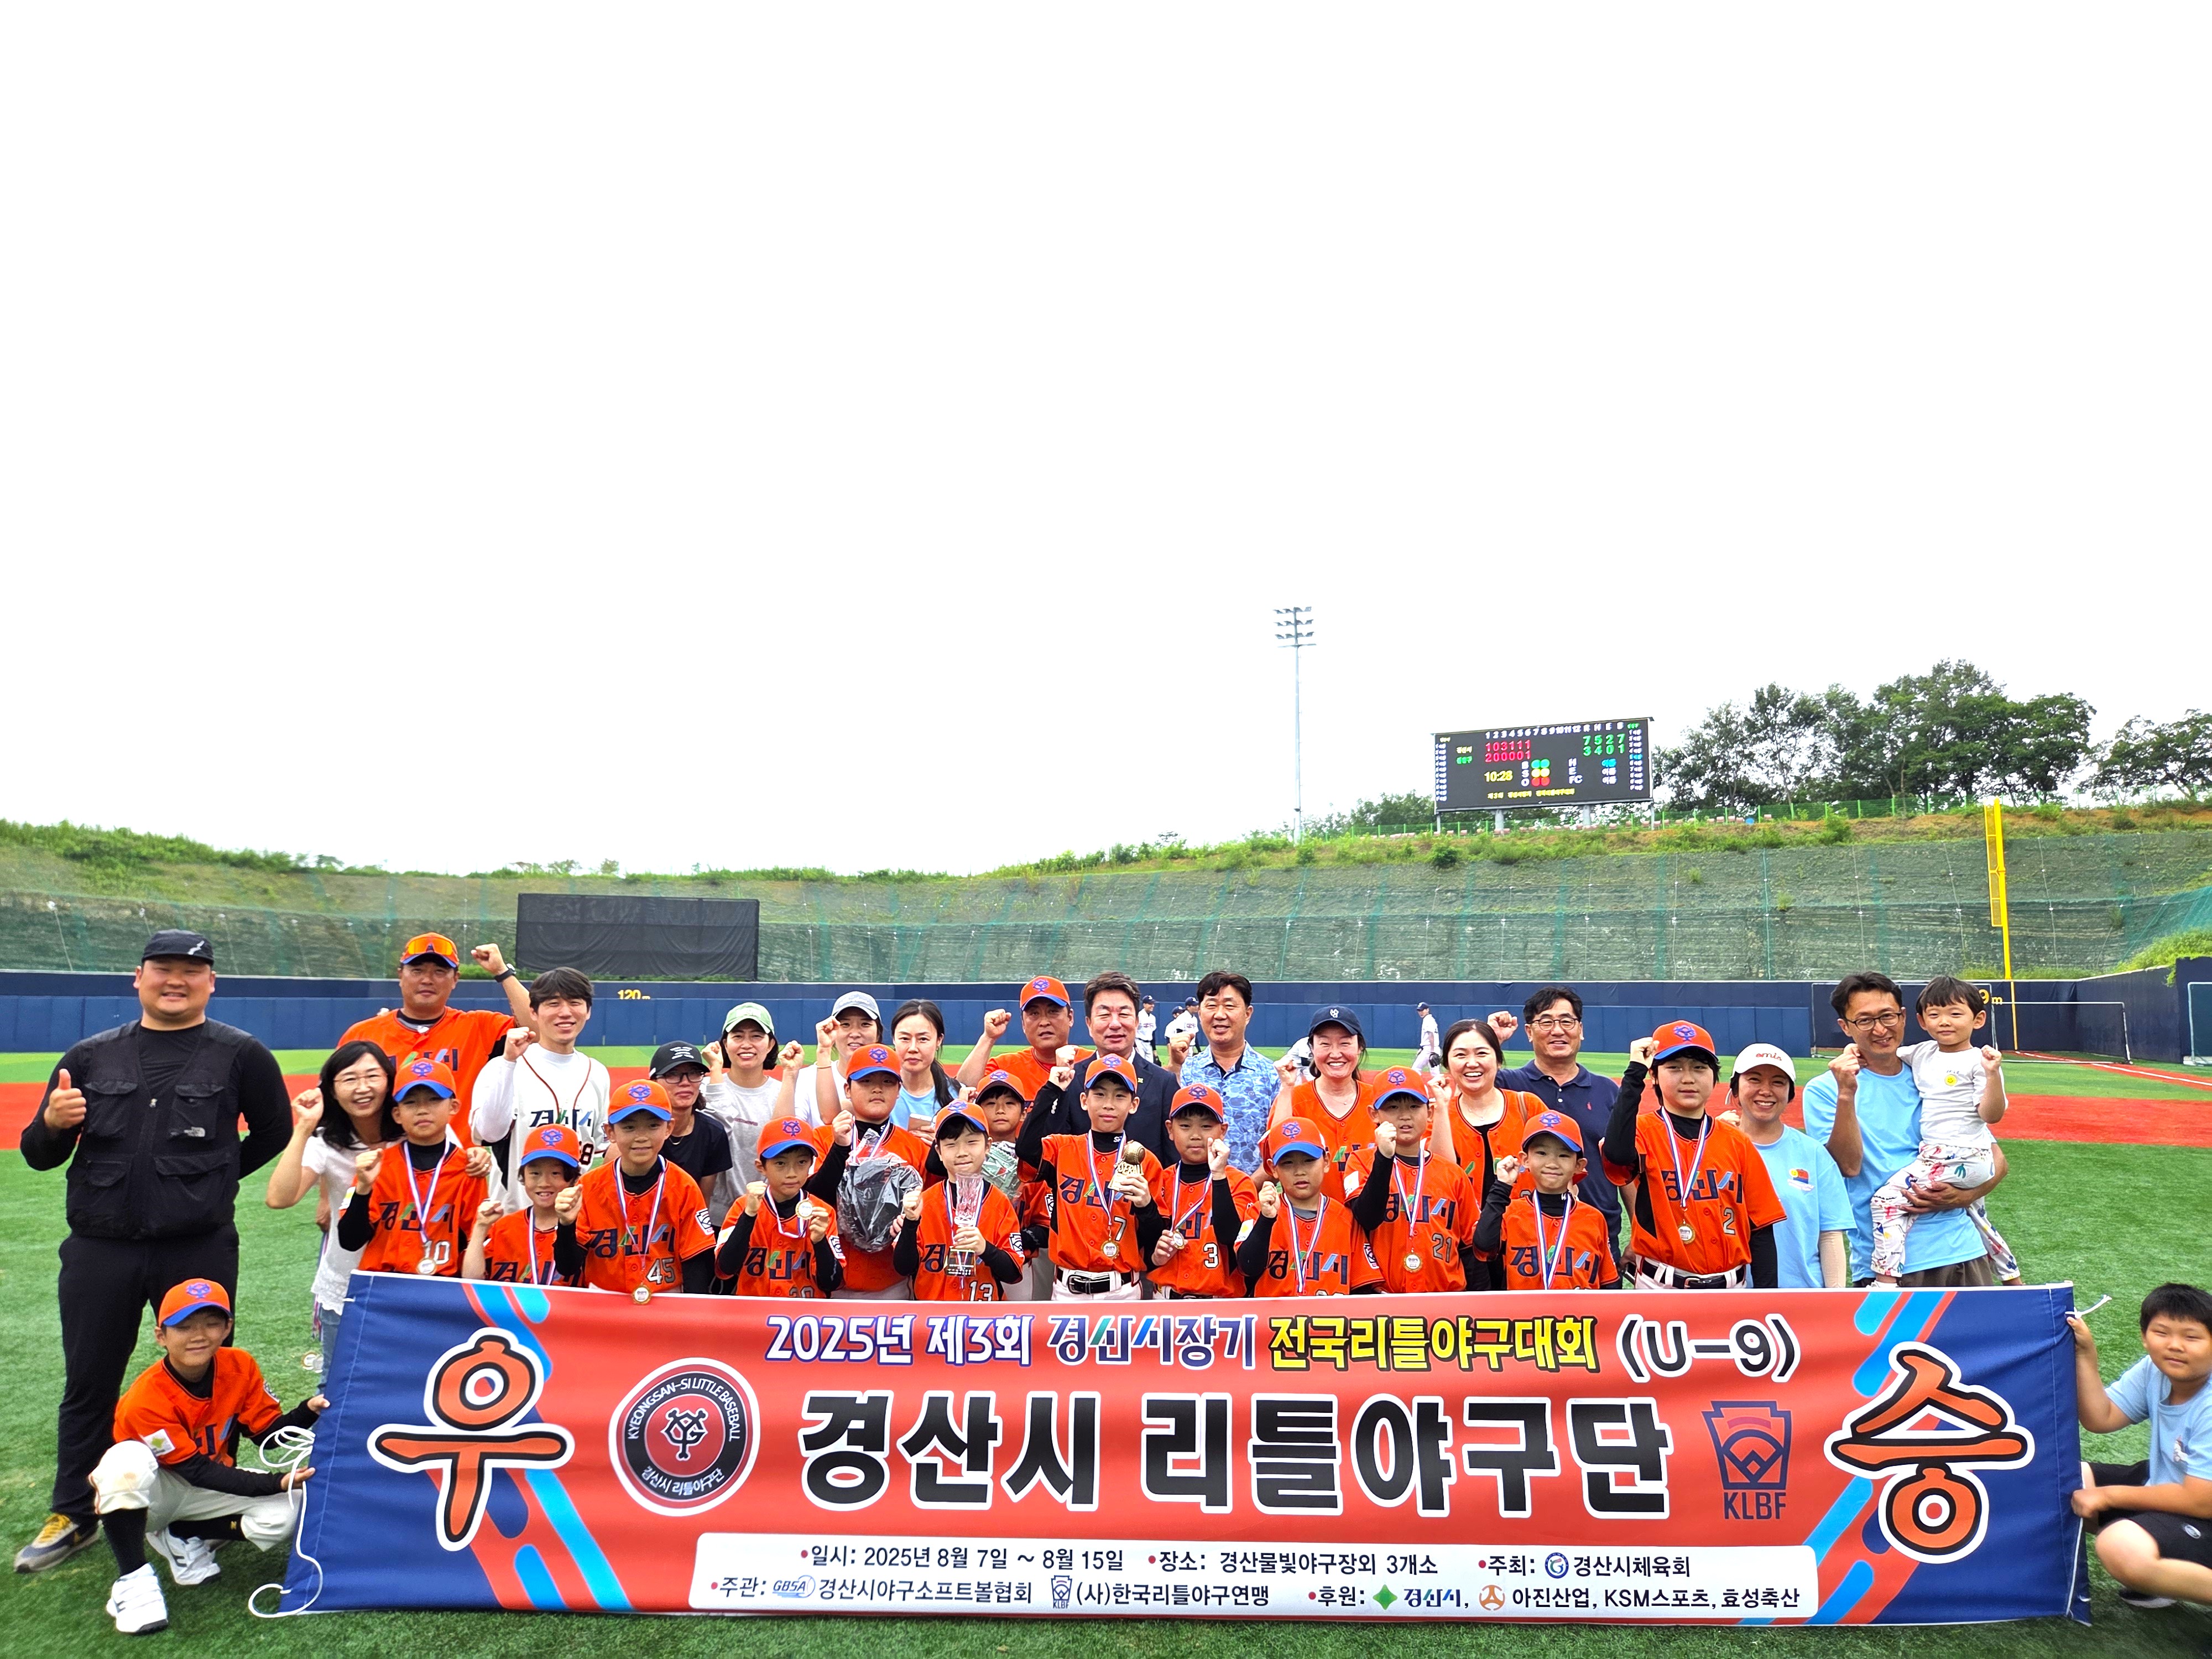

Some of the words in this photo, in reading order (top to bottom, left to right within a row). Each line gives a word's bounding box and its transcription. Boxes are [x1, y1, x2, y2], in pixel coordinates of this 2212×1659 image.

[1484, 770, 1512, 782] 10:28
[1569, 775, 1583, 784] FC
[1114, 1216, 1127, 1241] 7
[1723, 1207, 1736, 1235] 2
[424, 1239, 450, 1265] 10
[1203, 1242, 1219, 1269] 3
[646, 1258, 676, 1285] 45
[969, 1280, 994, 1301] 13
[766, 1315, 915, 1365] 2025년
[926, 1314, 1035, 1366] 제3회
[1047, 1314, 1258, 1370] 경산시장기
[1267, 1314, 1600, 1373] 전국리틀야구대회
[1618, 1316, 1798, 1380] (U-9)
[692, 1378, 724, 1397] LITTLE
[718, 1390, 740, 1442] BASEBALL
[373, 1332, 570, 1547] 우
[1828, 1346, 2031, 1556] 승
[801, 1394, 1097, 1507] 경산시
[1144, 1394, 1670, 1514] 리틀야구단
[1724, 1491, 1787, 1520] KLBF
[812, 1545, 855, 1566] 일시:
[864, 1547, 930, 1567] 2025년
[937, 1547, 968, 1568] 8월
[977, 1548, 1006, 1569] 7일
[1043, 1548, 1073, 1570] 8월
[1082, 1550, 1123, 1571] 15일
[1159, 1551, 1205, 1572] 장소:
[1220, 1551, 1375, 1575] 경산물빛야구장외
[1386, 1554, 1438, 1575] 3개소
[1488, 1555, 1535, 1576] 주최:
[1574, 1556, 1690, 1577] 경산시체육회
[720, 1577, 766, 1598] 주관:
[773, 1580, 806, 1592] GBSA
[819, 1579, 1031, 1604] 경산시야구소프트볼협회
[1077, 1582, 1269, 1606] (사)한국리틀야구연맹
[1318, 1586, 1365, 1605] 후원:
[1512, 1588, 1597, 1609] 아진산업,
[1605, 1589, 1716, 1609] KSM스포츠,
[1721, 1588, 1800, 1609] 효성축산
